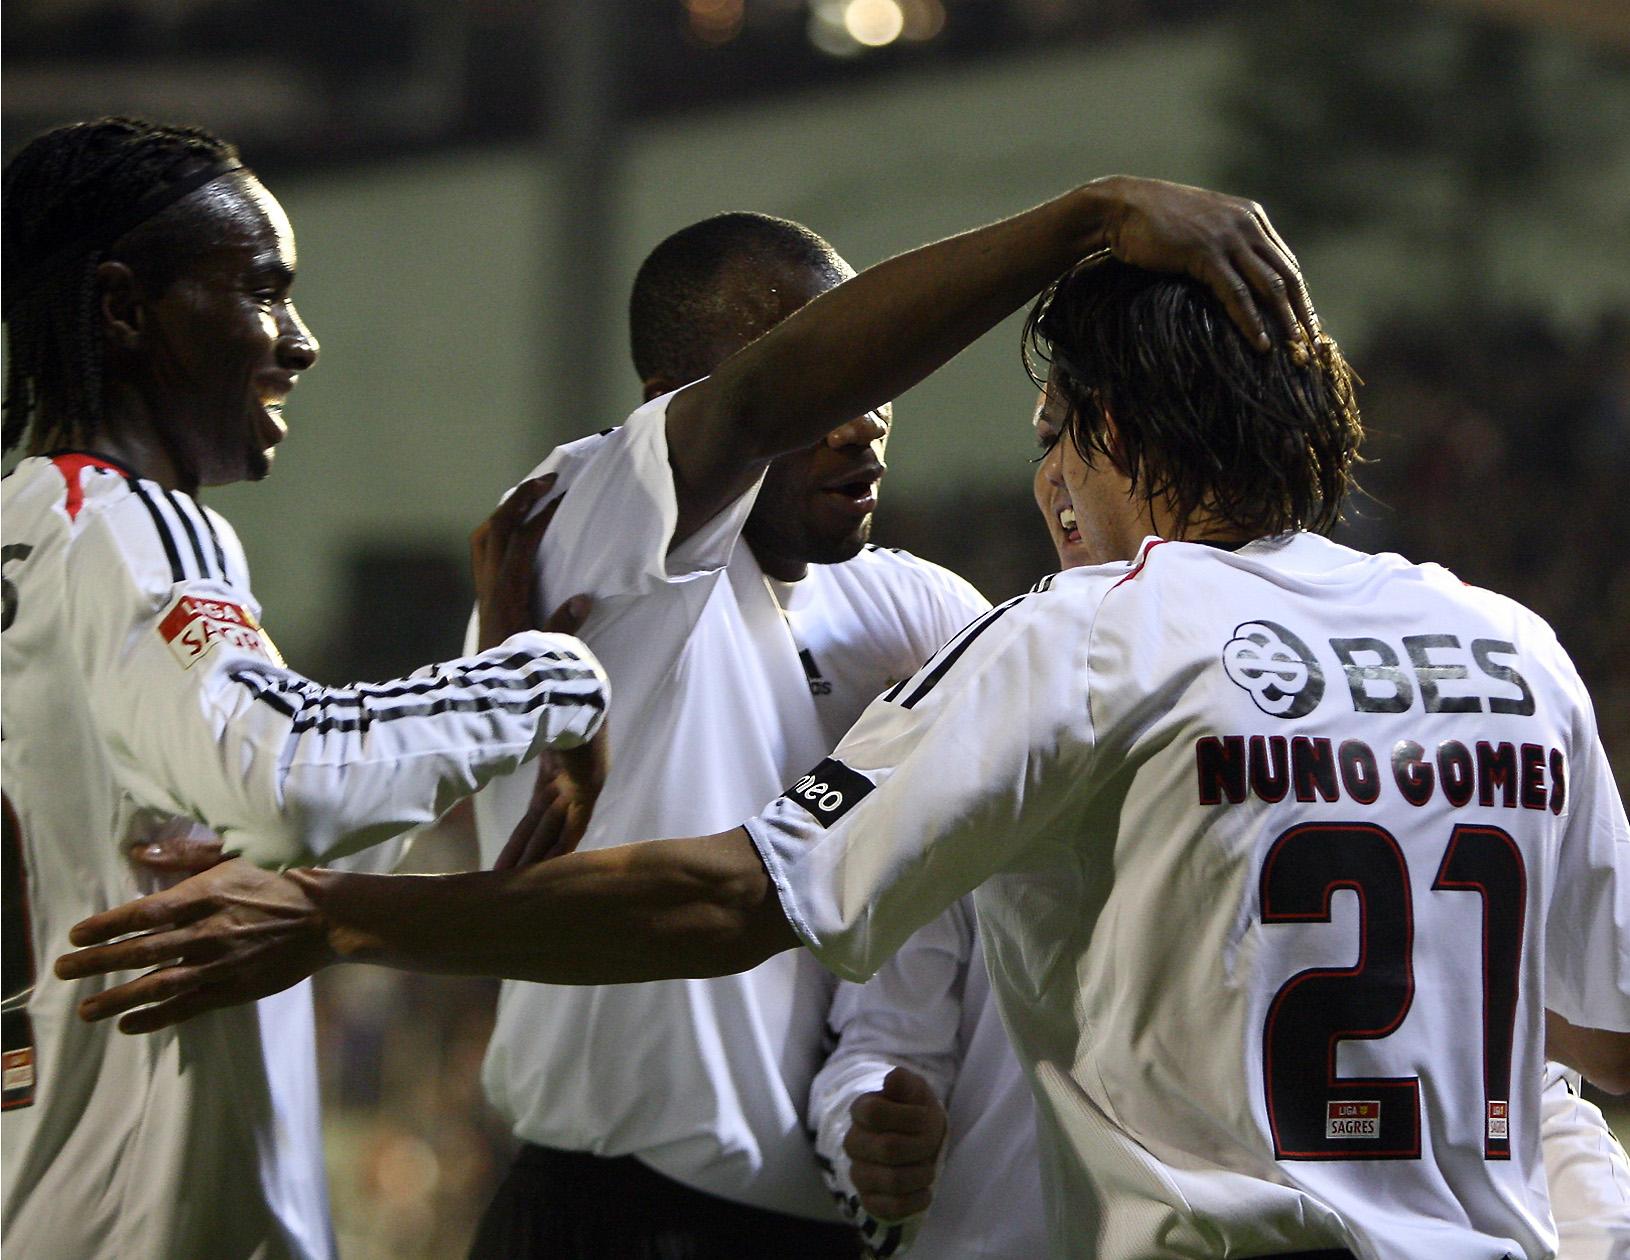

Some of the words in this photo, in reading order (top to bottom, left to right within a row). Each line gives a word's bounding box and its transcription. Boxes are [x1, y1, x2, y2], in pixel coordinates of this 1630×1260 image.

[1328, 633, 1536, 716] BES
[1195, 735, 1381, 806] NUNO
[1391, 738, 1566, 816] GOMES
[1259, 821, 1528, 1161] 21
[1331, 1120, 1375, 1134] SAGRES
[1338, 1105, 1358, 1116] LIGA
